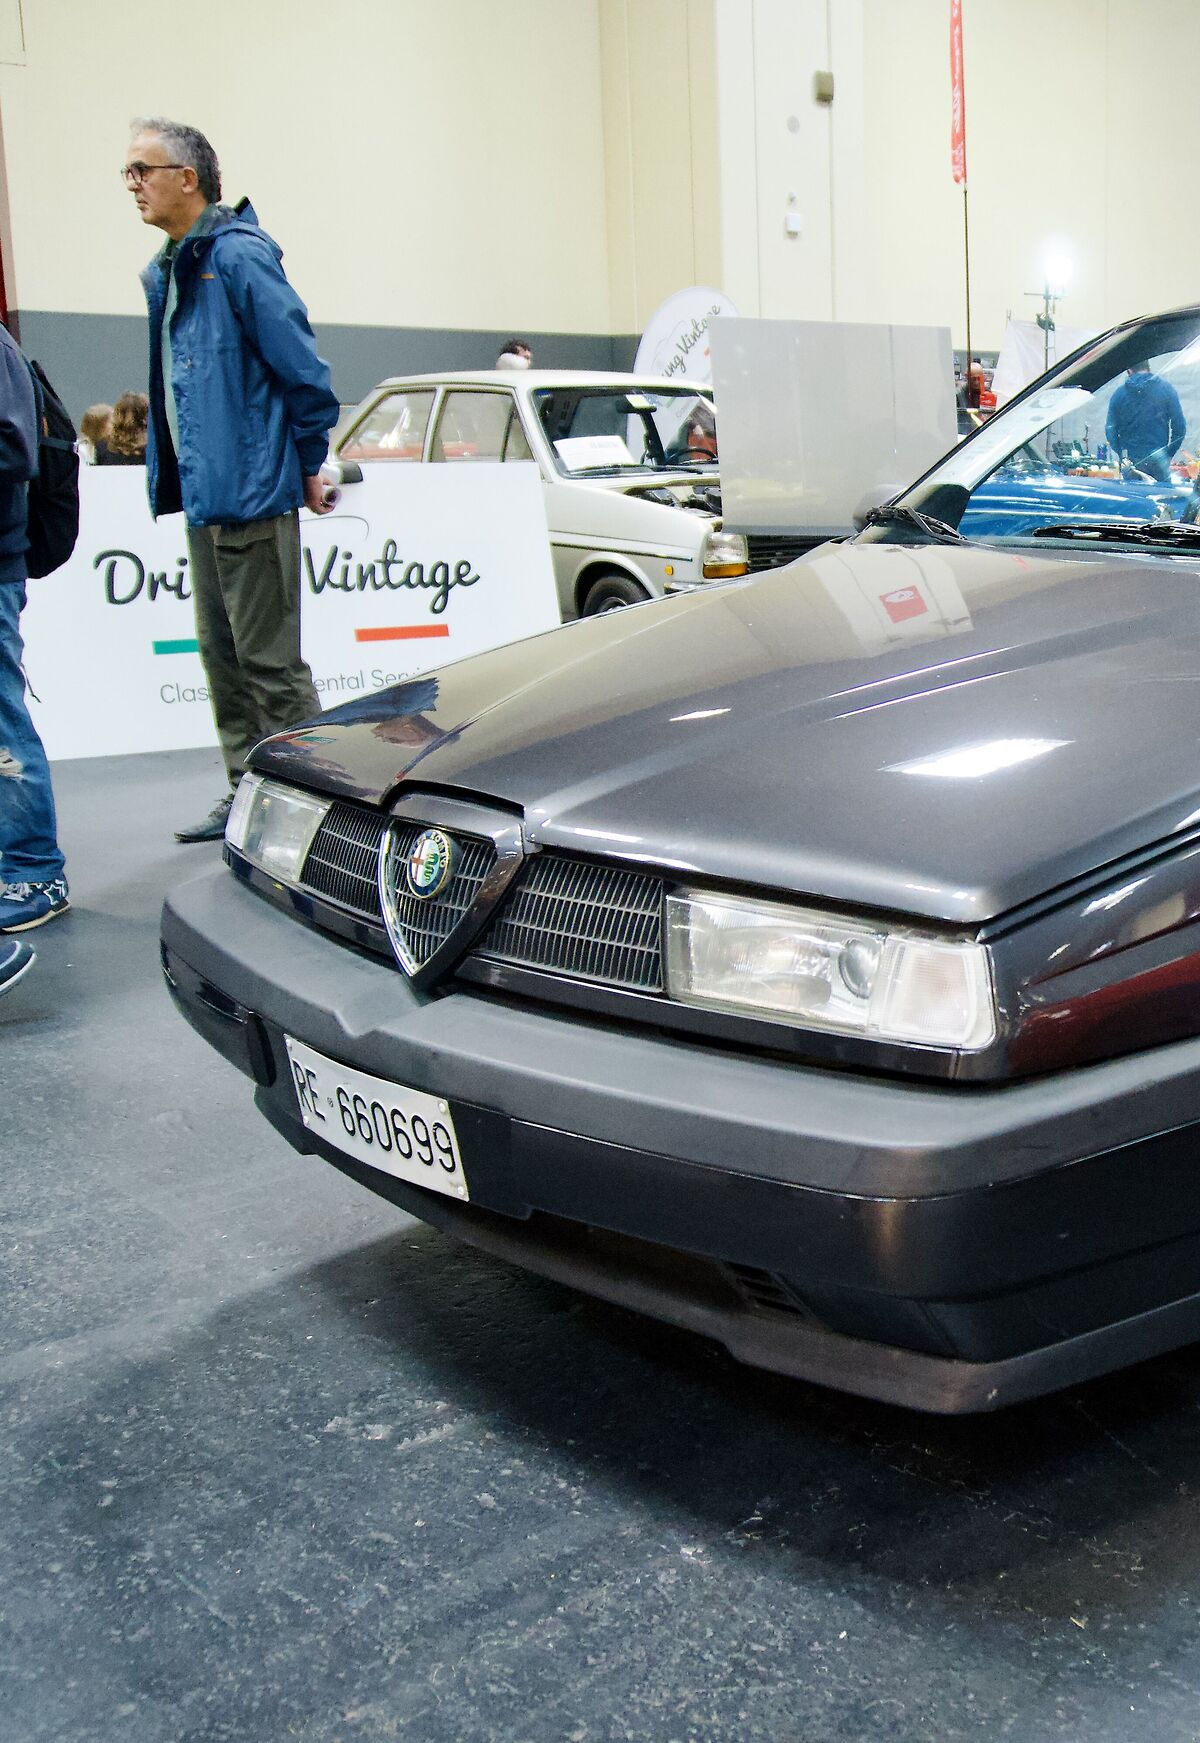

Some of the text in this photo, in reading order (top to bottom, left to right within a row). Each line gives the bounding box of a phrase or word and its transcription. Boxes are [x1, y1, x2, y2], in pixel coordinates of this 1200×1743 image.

[93, 538, 481, 614] Dri Vintage
[160, 682, 209, 704] Clas
[313, 670, 365, 692] ental
[292, 1059, 457, 1173] RE 660699
